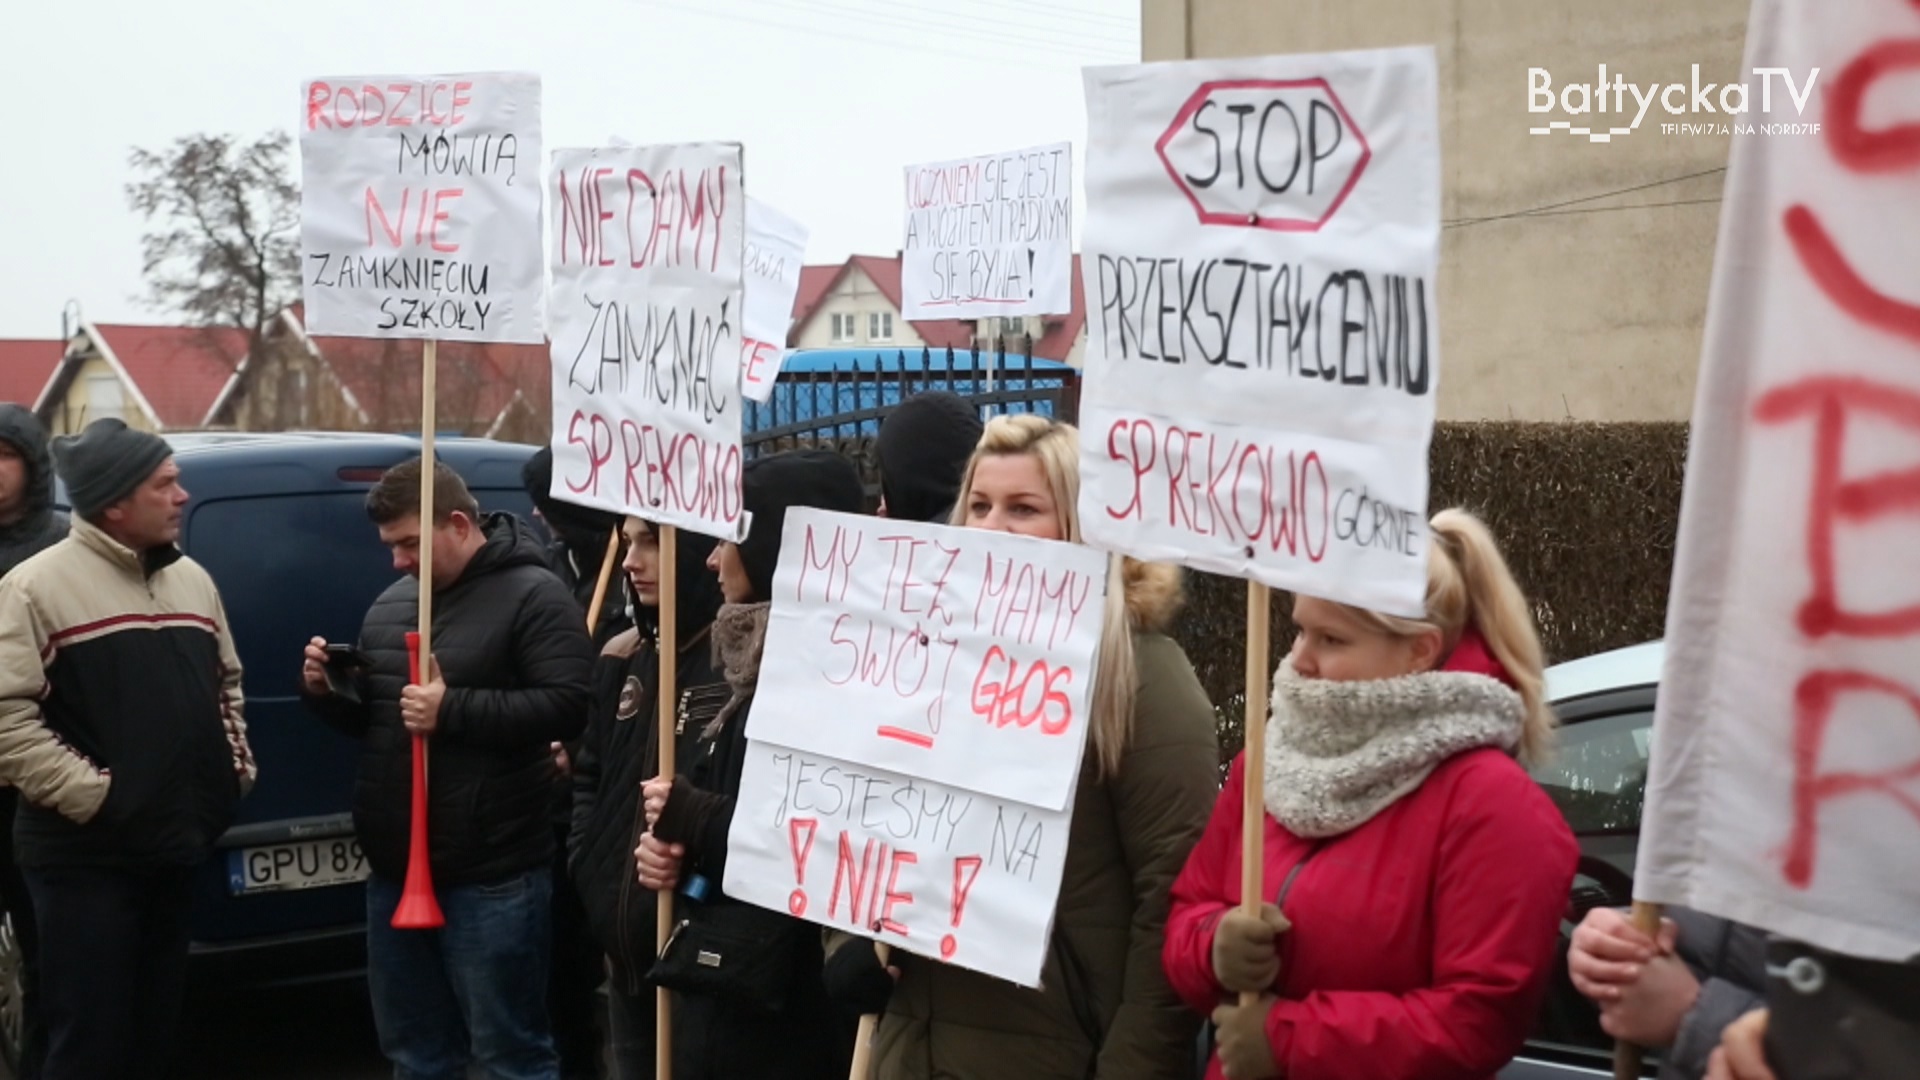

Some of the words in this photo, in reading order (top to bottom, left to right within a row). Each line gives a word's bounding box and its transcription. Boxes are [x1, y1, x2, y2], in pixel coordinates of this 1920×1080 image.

[307, 81, 473, 130] RODZICE
[1185, 98, 1342, 196] STOP
[398, 130, 518, 186] MÓWIĄ
[906, 160, 980, 210] UCZNIEM
[1018, 149, 1064, 199] JEST
[364, 186, 464, 253] NIE
[559, 165, 615, 267] NIE
[626, 165, 726, 273] DAMY
[905, 211, 919, 250] A
[1007, 197, 1069, 244] RADNYM
[309, 253, 490, 298] ZAMKNIĘCIU
[377, 297, 492, 332] SZKOŁY
[1097, 253, 1429, 396] PRZEKSZTAŁCENIU
[568, 293, 731, 424] ZAMKNĄĆ
[565, 409, 613, 497] SP
[620, 419, 742, 523] REKOWO
[1105, 418, 1156, 521] SP
[1163, 426, 1329, 562] REKOWO
[1333, 485, 1419, 557] GÓRNE
[799, 524, 863, 603] MY
[974, 551, 1091, 651] MAMY
[821, 613, 959, 734] SWÓJ
[971, 644, 1073, 736] GŁOS
[250, 843, 319, 884] GPU
[772, 753, 973, 852] JESTEŚMY
[988, 804, 1043, 883] NA
